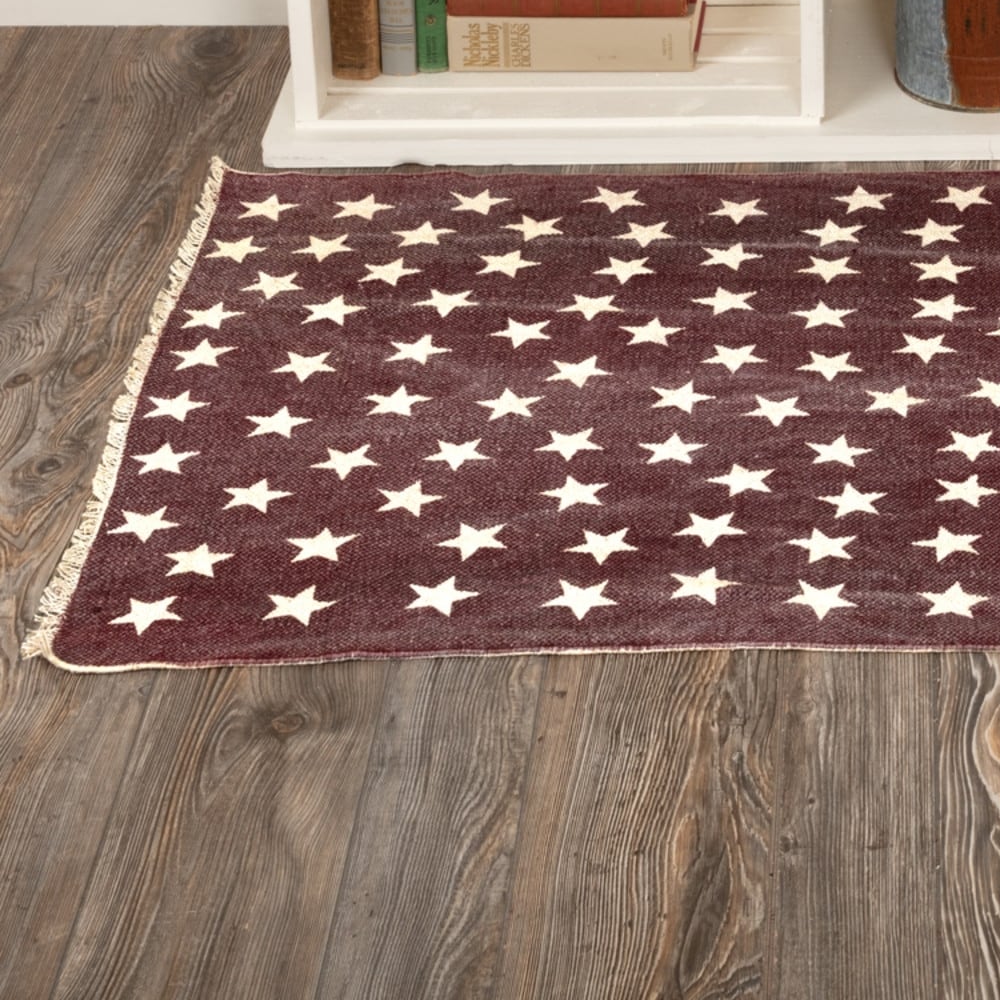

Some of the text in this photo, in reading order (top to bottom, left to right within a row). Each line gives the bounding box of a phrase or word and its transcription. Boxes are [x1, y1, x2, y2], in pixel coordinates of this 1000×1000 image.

[462, 23, 481, 67] Nicholas
[480, 23, 502, 67] Nickleby
[510, 23, 520, 67] CHARLES
[519, 23, 531, 67] DICKENS
